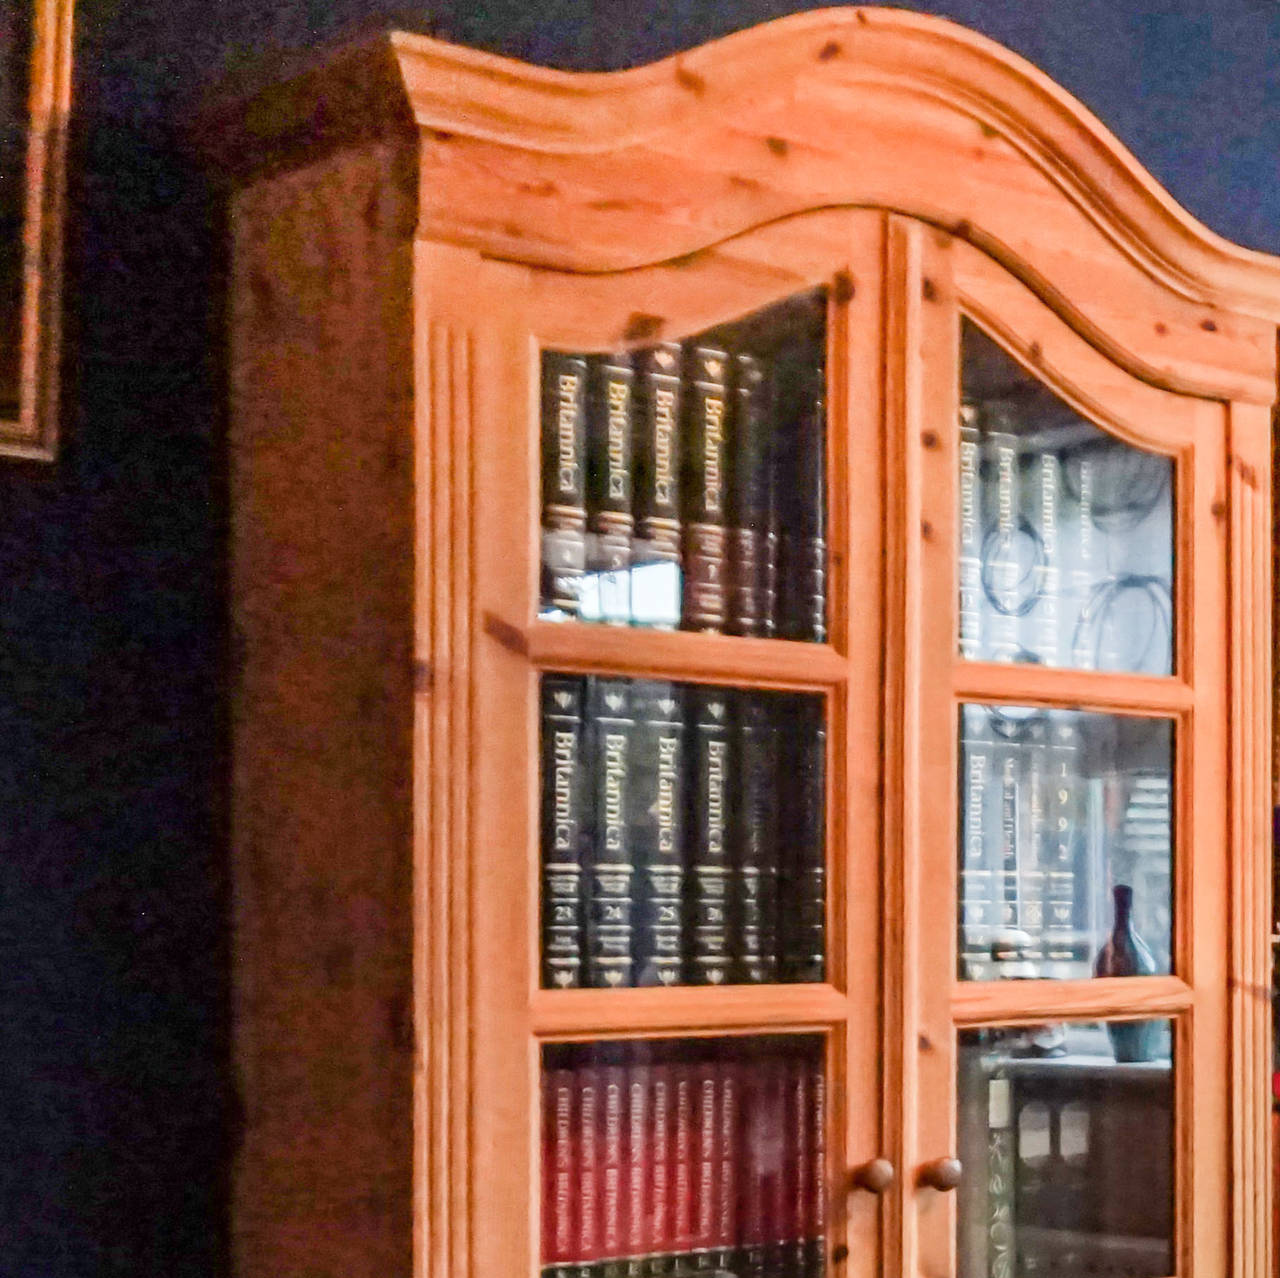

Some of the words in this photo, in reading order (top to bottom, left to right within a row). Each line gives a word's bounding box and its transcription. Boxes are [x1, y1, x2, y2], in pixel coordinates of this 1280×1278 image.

[558, 374, 578, 492] Britannica
[608, 381, 631, 499] Britannica
[654, 388, 677, 506] Britannica
[703, 395, 725, 512] Britannica
[961, 443, 976, 544] Britannica
[999, 449, 1014, 548] Britannica
[1042, 455, 1057, 554] Britannica
[555, 731, 577, 850] Britannica
[605, 734, 627, 851] Britannica
[658, 737, 680, 852] Britannica
[708, 741, 727, 854] Britannica
[968, 754, 987, 857] Britannica
